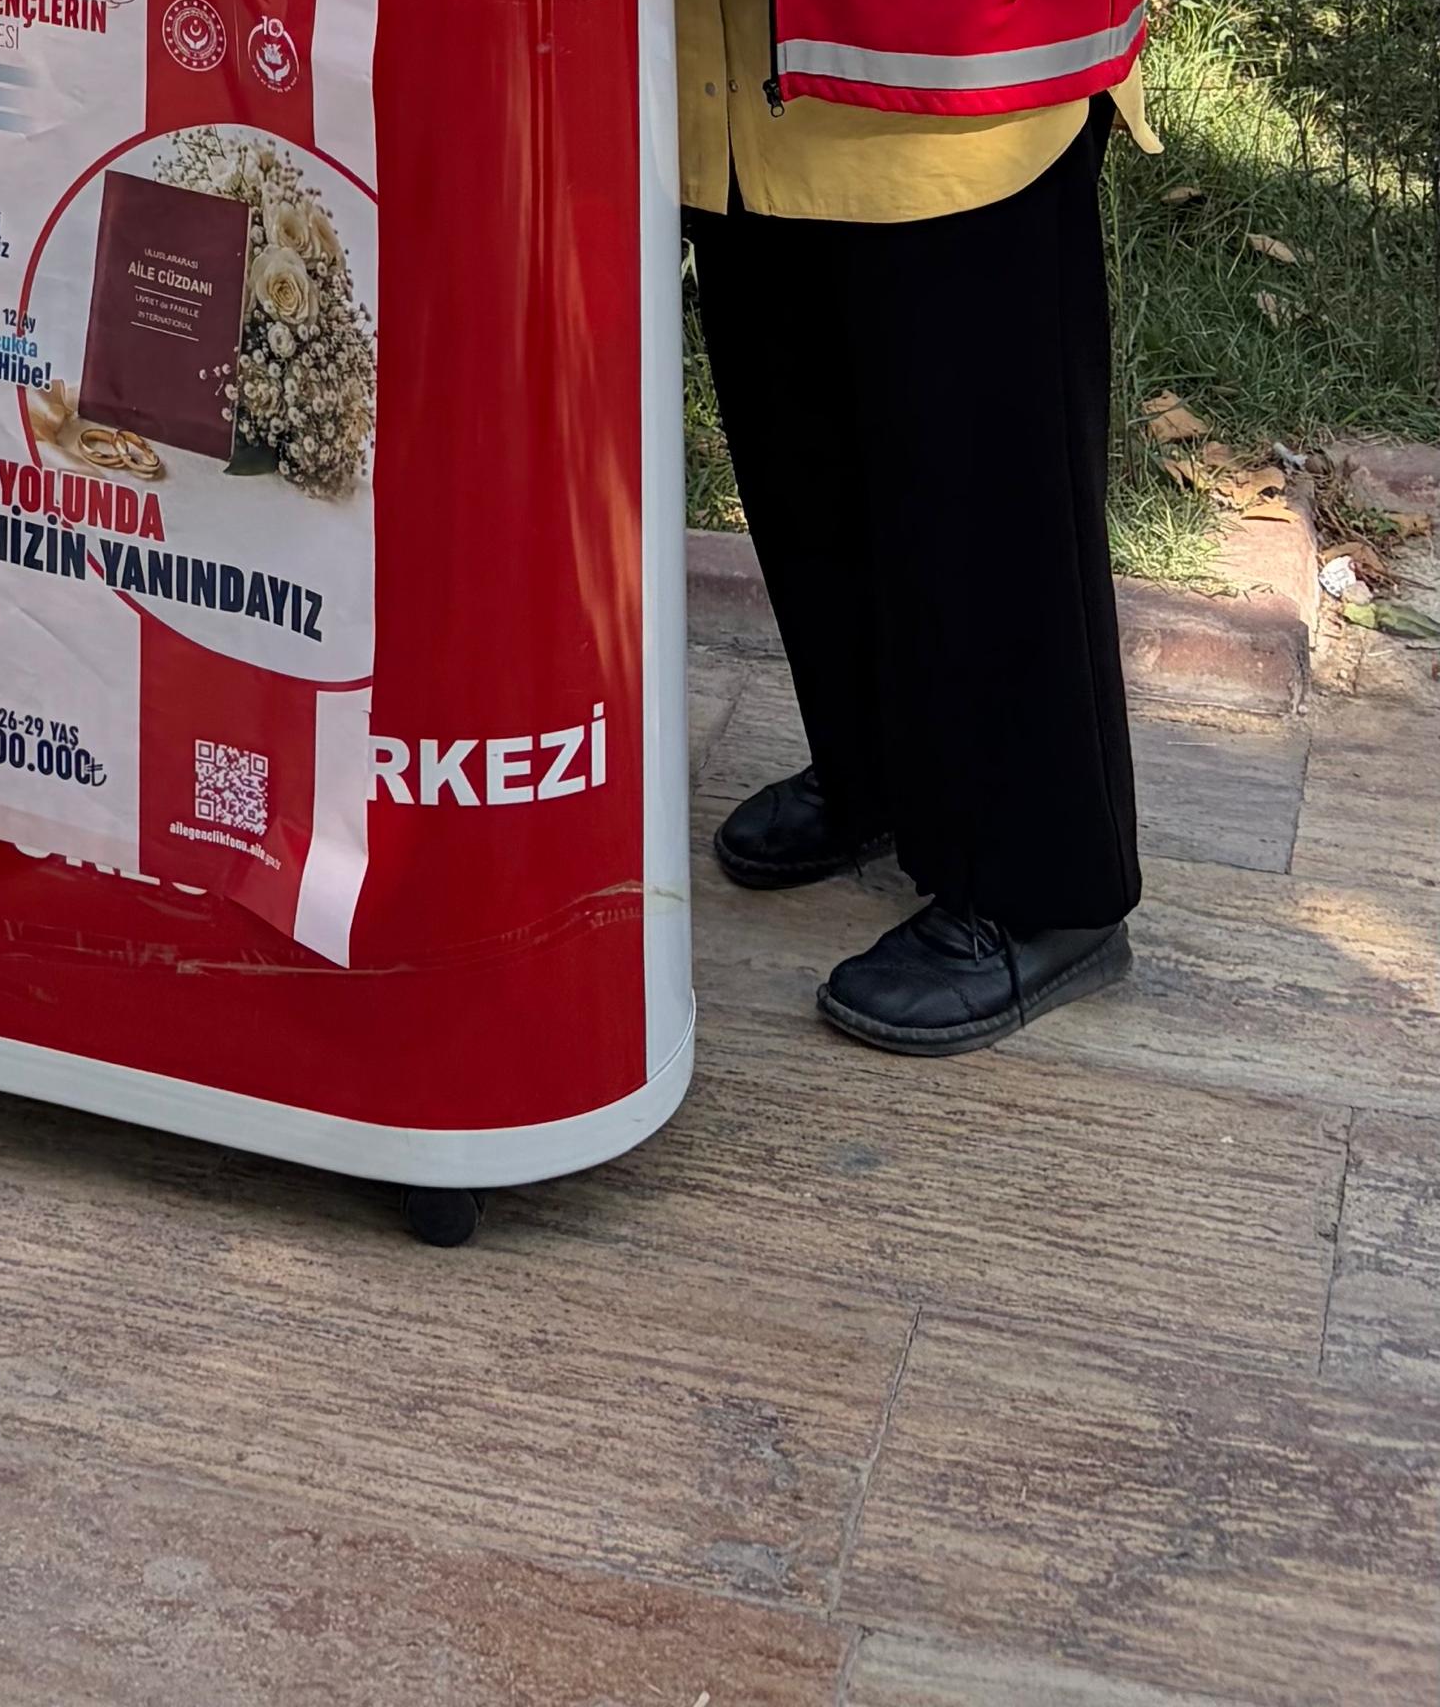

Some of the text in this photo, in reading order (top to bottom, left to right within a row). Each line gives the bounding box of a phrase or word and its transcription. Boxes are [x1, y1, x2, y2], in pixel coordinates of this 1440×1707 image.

[127, 260, 213, 297] AİLE CÜZDANI
[2, 308, 17, 327] 12
[21, 313, 36, 334] Ay
[99, 537, 324, 643] YANINDAYIZ
[49, 720, 80, 751] YAŞ
